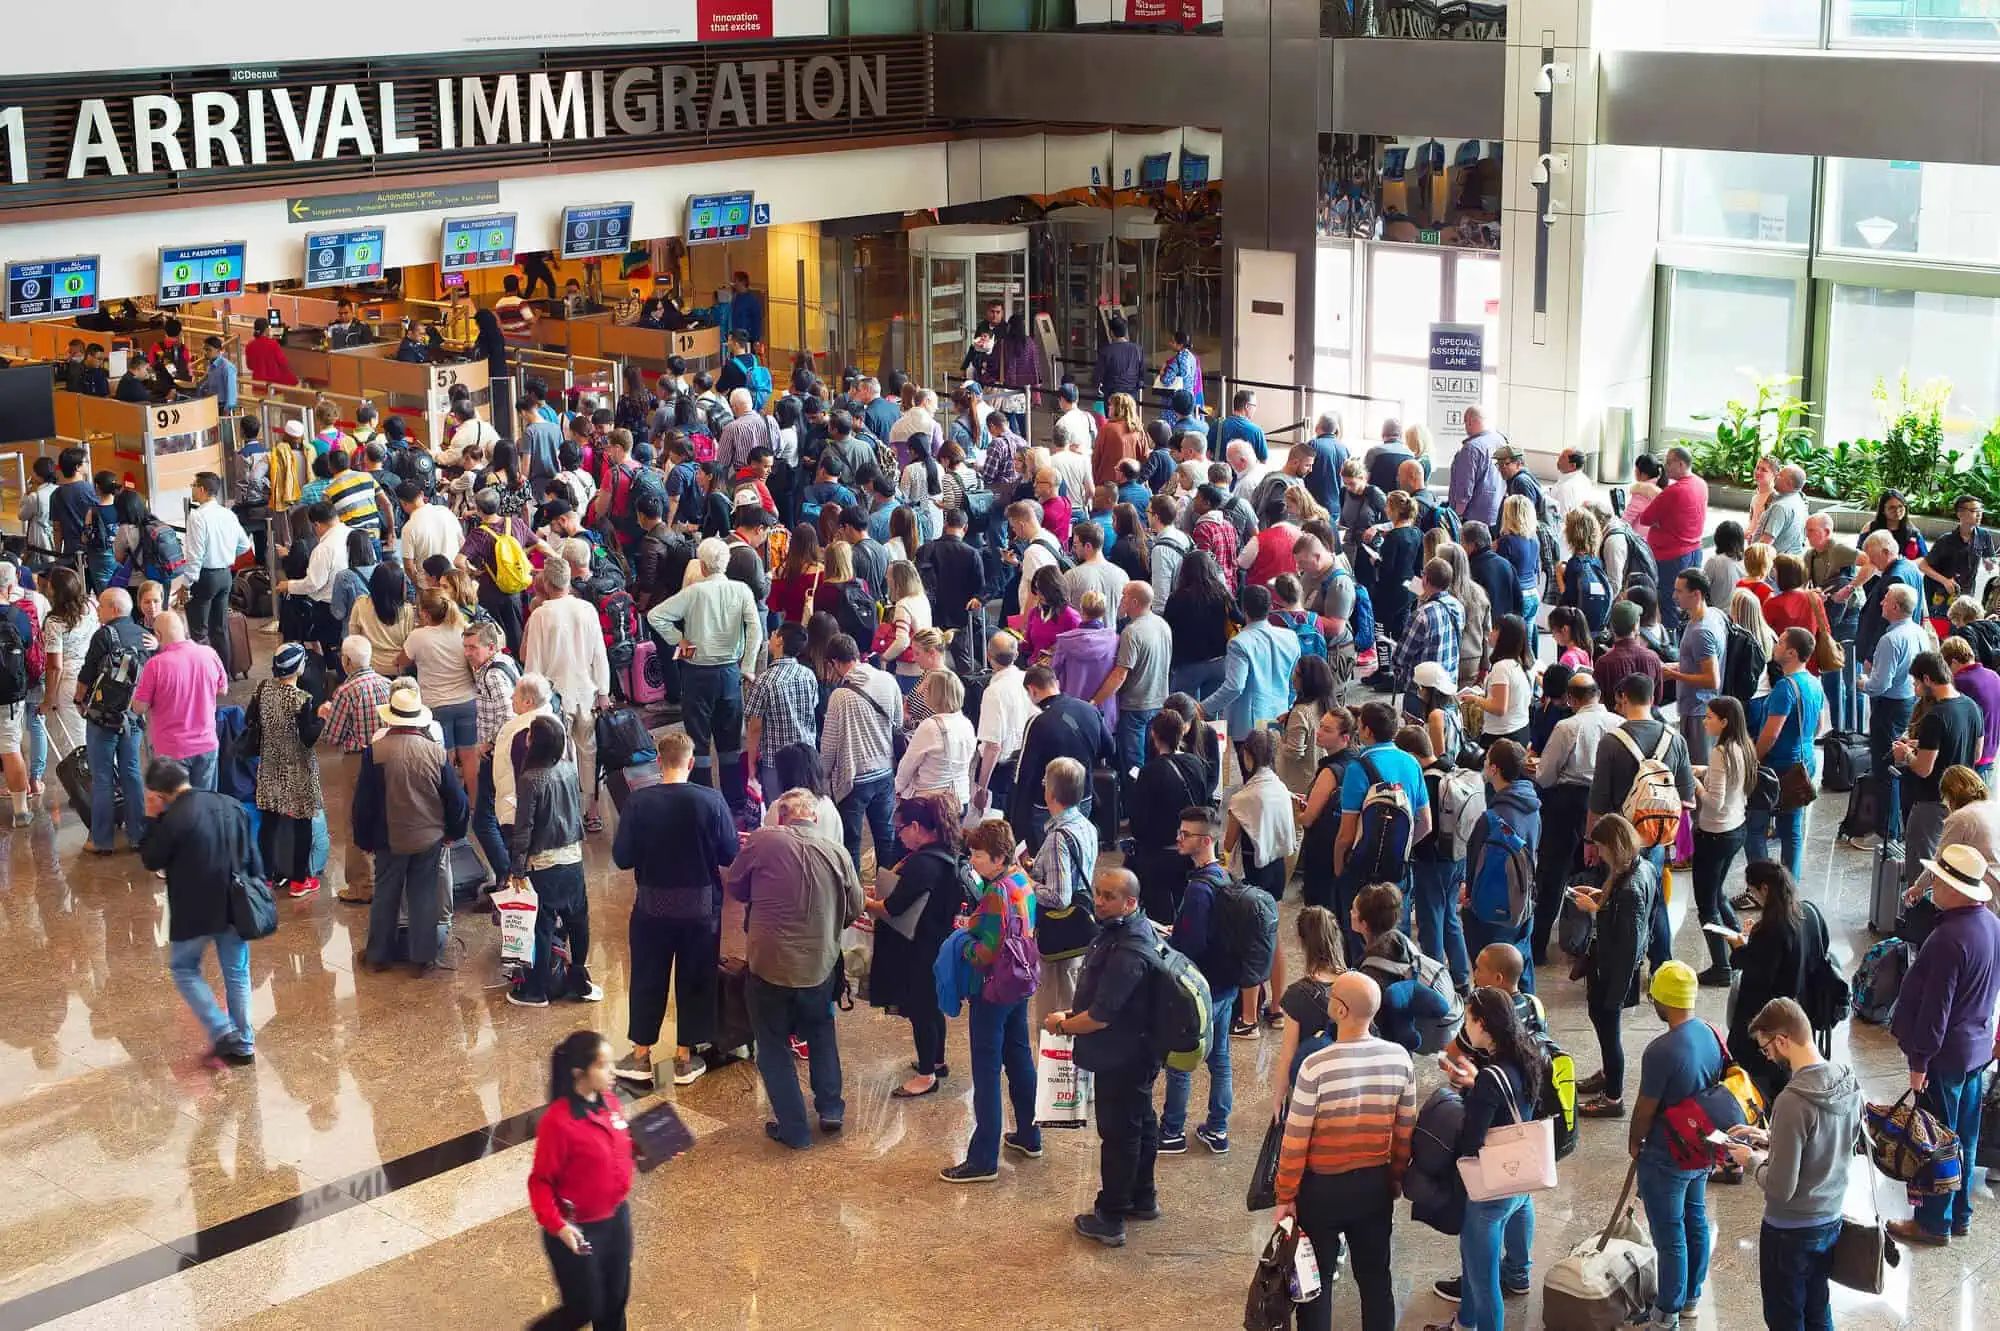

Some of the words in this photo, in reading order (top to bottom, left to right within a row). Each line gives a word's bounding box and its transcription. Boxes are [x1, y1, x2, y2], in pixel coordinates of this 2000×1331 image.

[712, 12, 758, 23] Innovation
[711, 23, 728, 32] that
[730, 22, 760, 31] excites
[232, 70, 278, 80] JCDecaux
[66, 82, 419, 179] ARRIVAL
[438, 54, 887, 150] IMMIGRATION
[192, 248, 227, 257] PASSPORTS
[180, 268, 186, 277] 10
[27, 283, 35, 294] 12
[71, 279, 77, 289] 11
[1440, 338, 1473, 346] SPECIAL
[1431, 347, 1480, 356] ASSISTANCE
